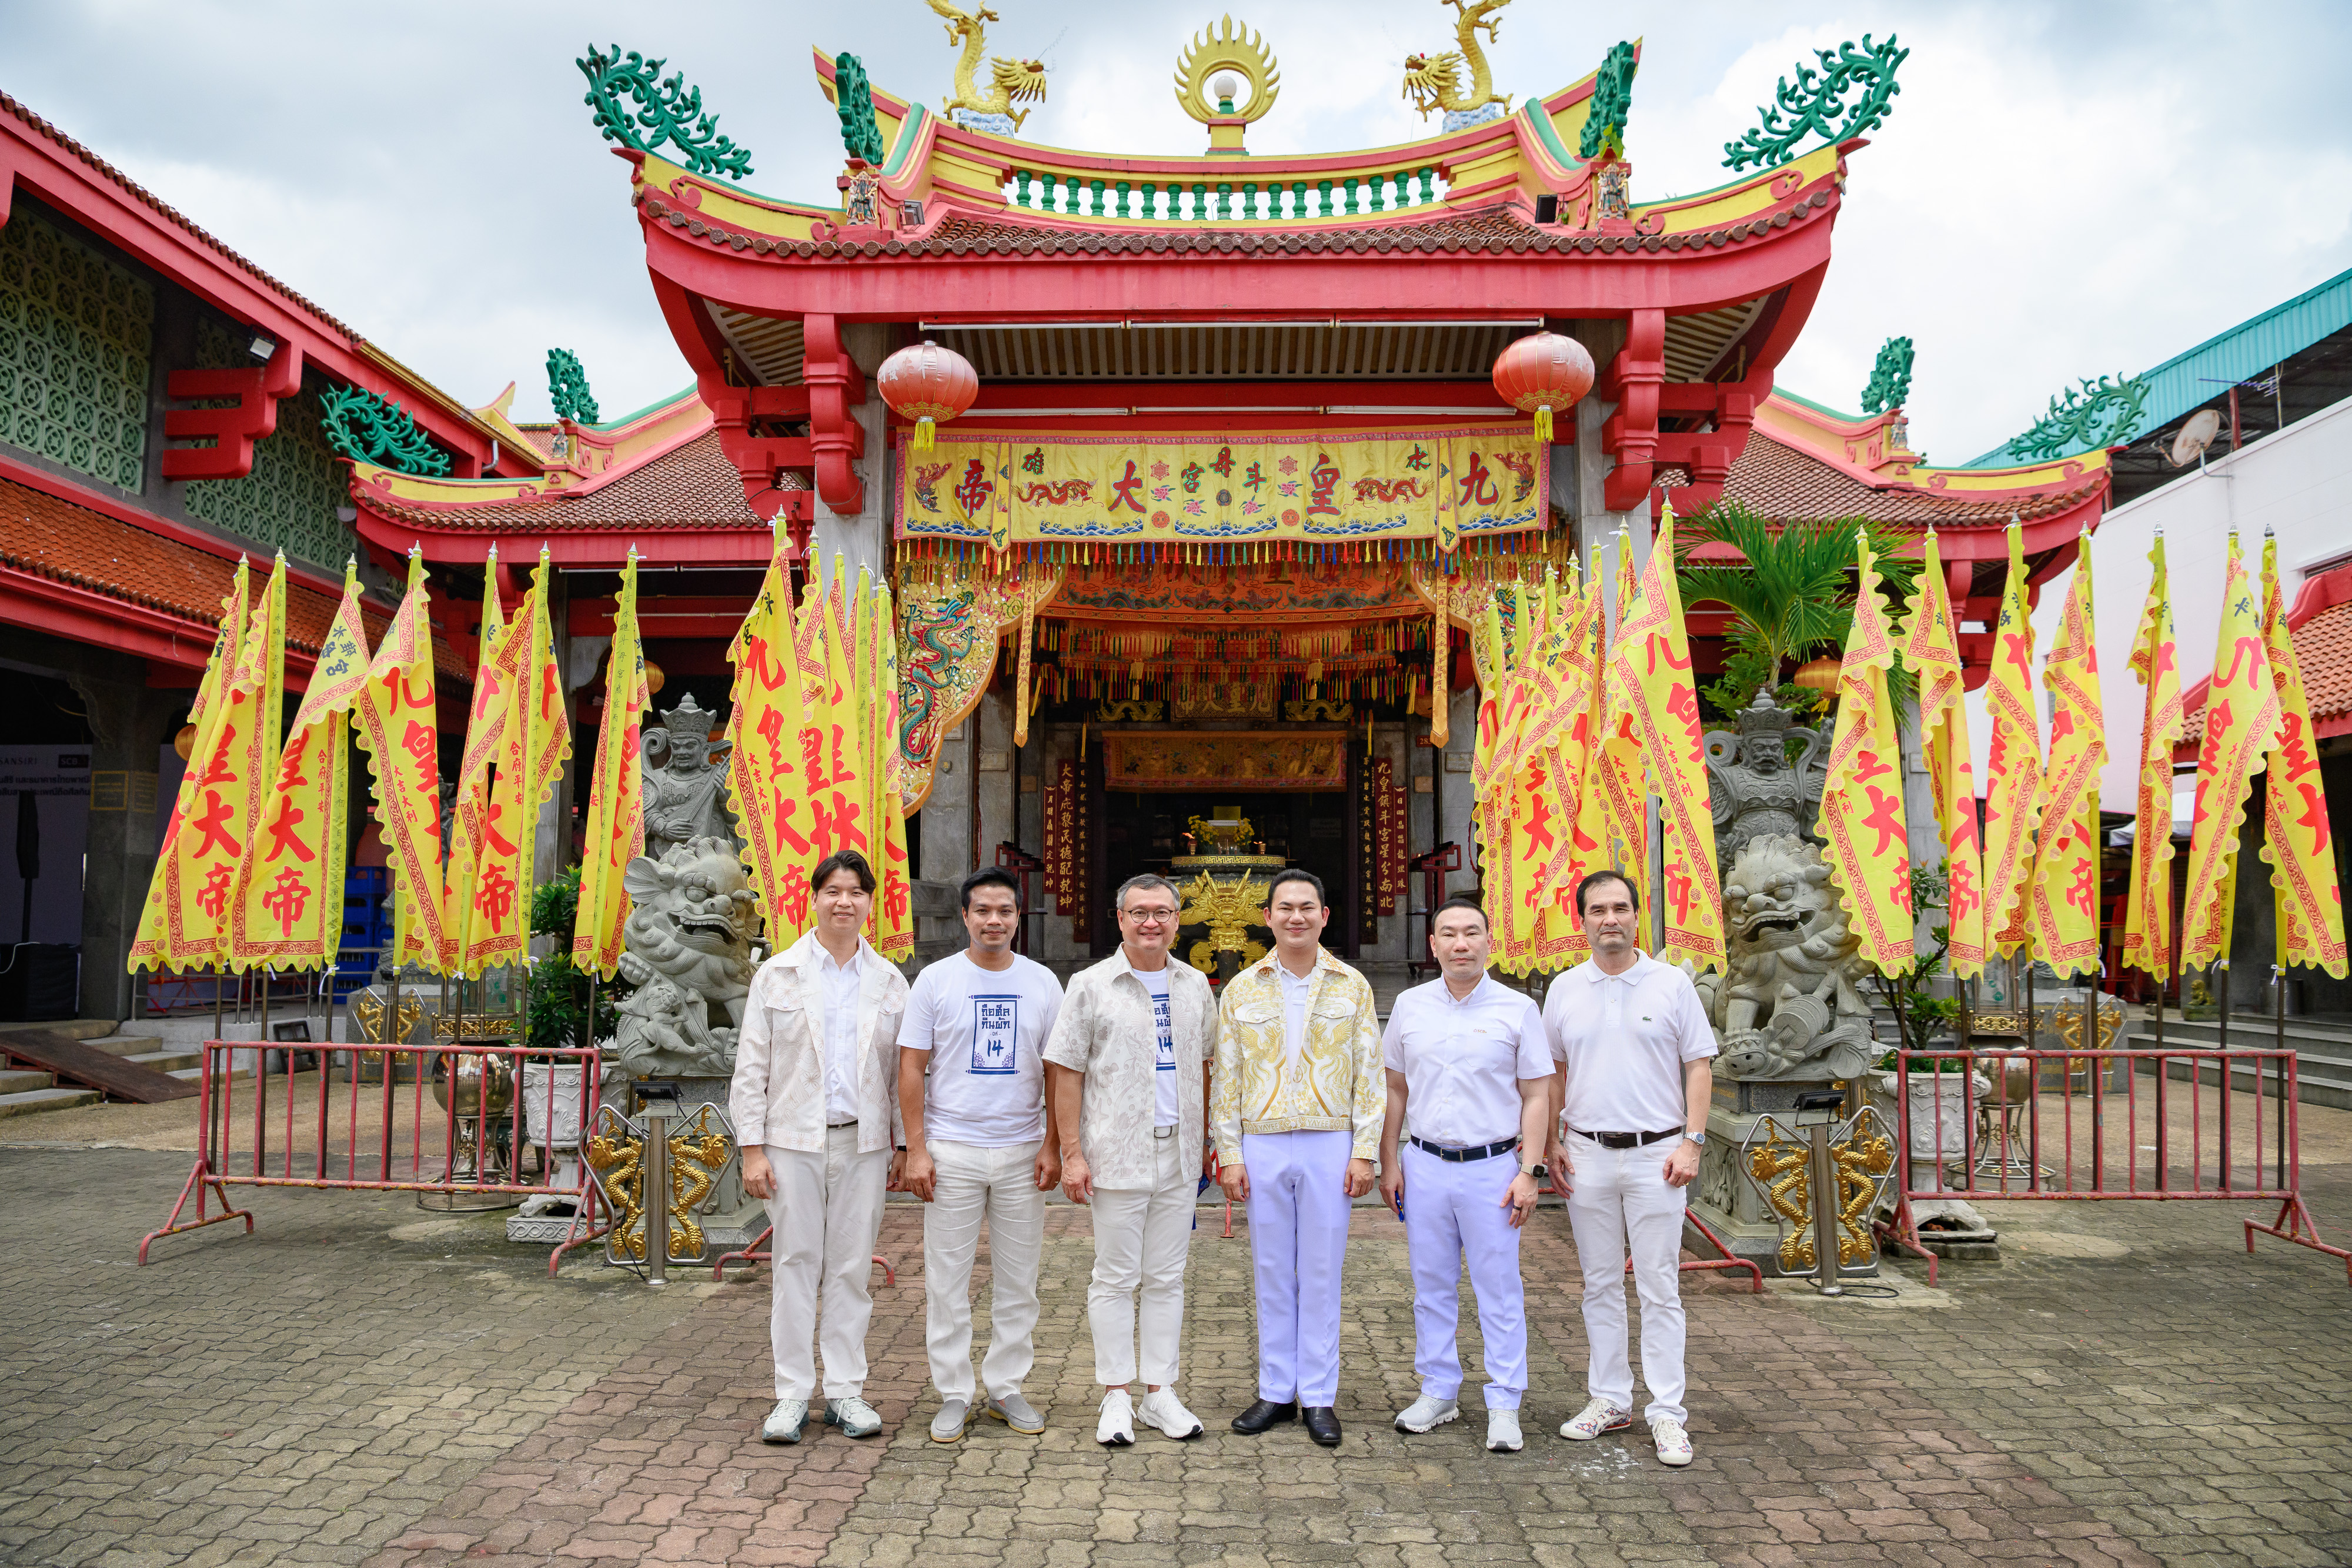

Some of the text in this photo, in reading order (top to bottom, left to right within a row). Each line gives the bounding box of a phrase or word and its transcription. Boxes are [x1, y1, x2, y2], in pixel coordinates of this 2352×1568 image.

[61, 757, 78, 765] SCB
[748, 753, 771, 817] 大吉大利
[1613, 755, 1643, 816] 大吉大利
[1662, 732, 1694, 797] 大吉大利
[393, 765, 418, 823] 大吉大利
[987, 1039, 1004, 1057] 14
